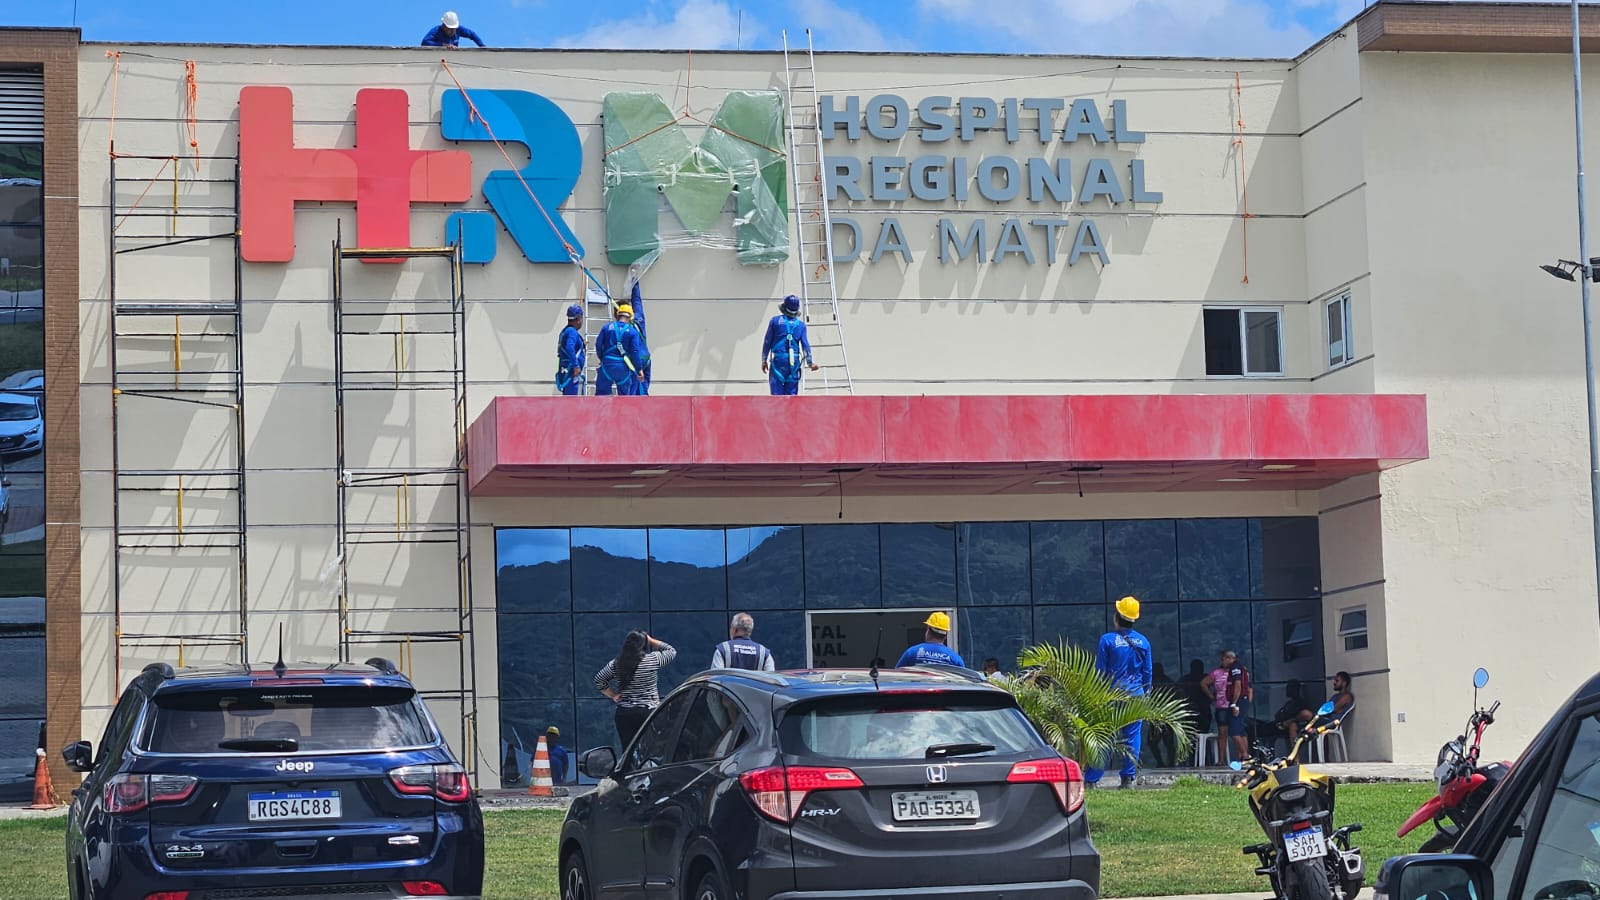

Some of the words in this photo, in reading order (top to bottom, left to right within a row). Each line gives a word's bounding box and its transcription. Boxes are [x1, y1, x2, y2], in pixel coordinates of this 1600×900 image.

[818, 94, 1147, 144] HOSPITAL
[824, 155, 1164, 204] REGIONAL
[828, 217, 914, 265] DA
[937, 218, 1111, 266] MATA
[275, 759, 315, 773] Jeep
[257, 799, 332, 818] RGS4C88
[800, 807, 842, 818] HR-V
[1294, 834, 1316, 847] SAH
